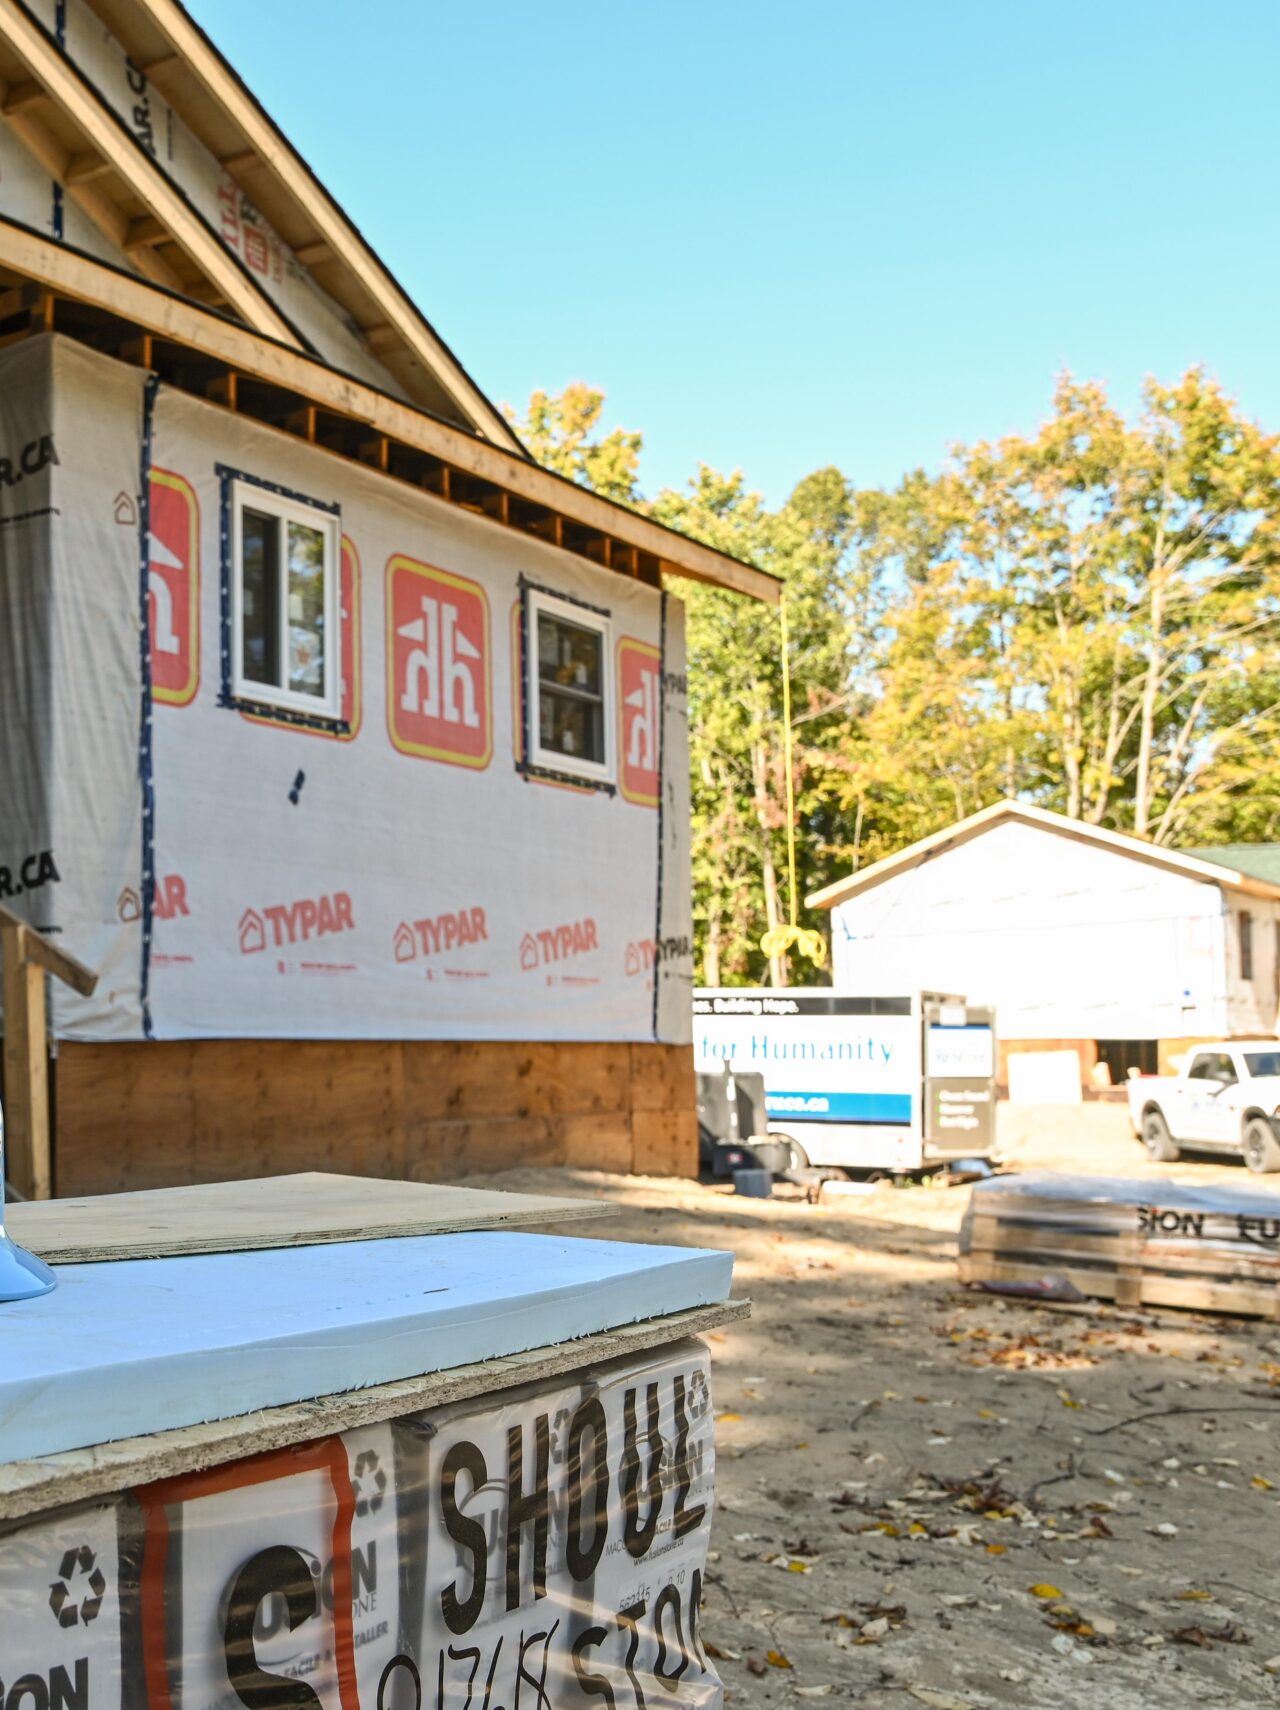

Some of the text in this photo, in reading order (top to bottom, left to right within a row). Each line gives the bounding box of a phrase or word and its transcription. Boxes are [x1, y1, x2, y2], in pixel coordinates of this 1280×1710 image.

[263, 892, 355, 947] TYPAR
[413, 906, 489, 956] TYPAR
[537, 918, 599, 964] TYPAR
[702, 1034, 894, 1066] for Humanity
[440, 1374, 707, 1636] SHOUL
